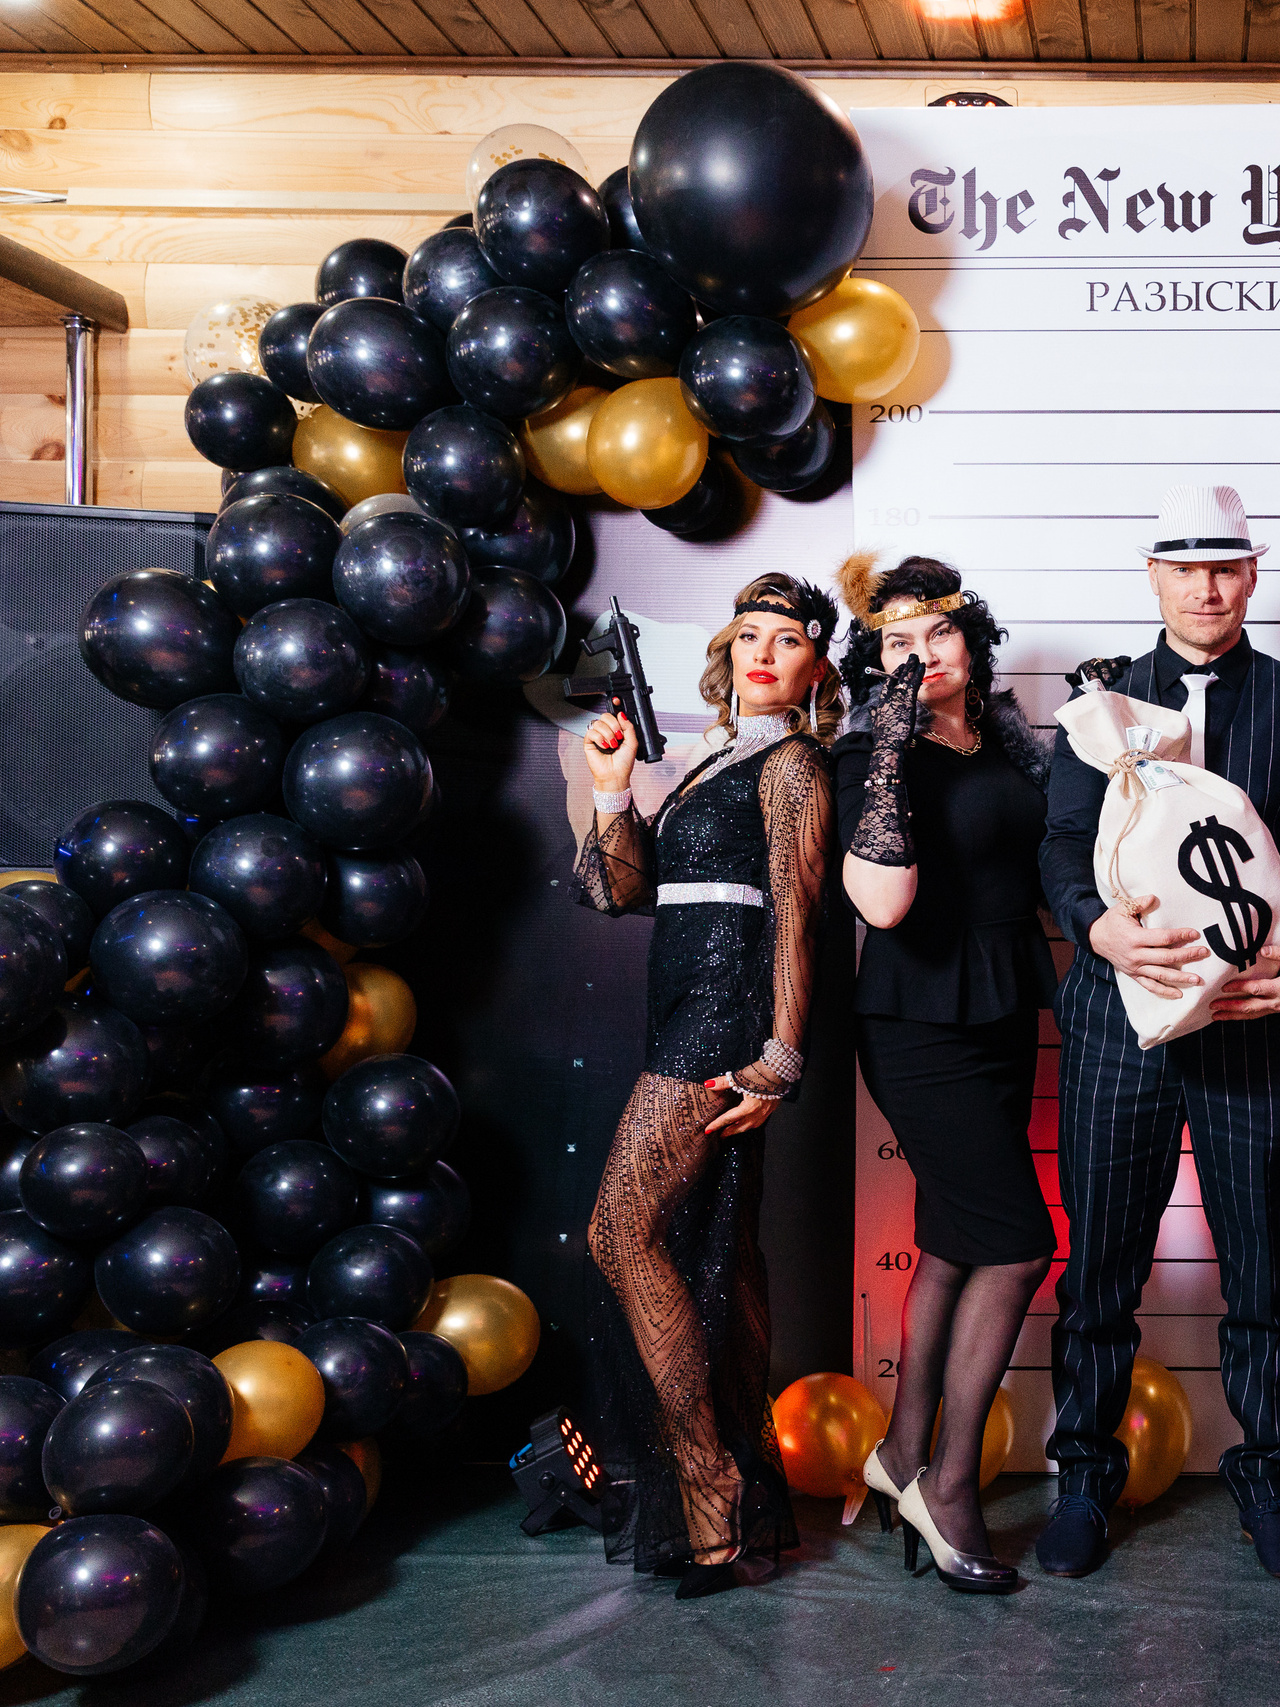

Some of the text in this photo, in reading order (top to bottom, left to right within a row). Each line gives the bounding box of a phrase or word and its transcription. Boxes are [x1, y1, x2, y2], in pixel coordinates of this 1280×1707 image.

[907, 166, 1036, 252] The
[1058, 166, 1218, 241] New
[868, 403, 923, 425] 200
[868, 507, 921, 527] 180
[875, 1251, 913, 1271] 40
[877, 1358, 901, 1378] 2
